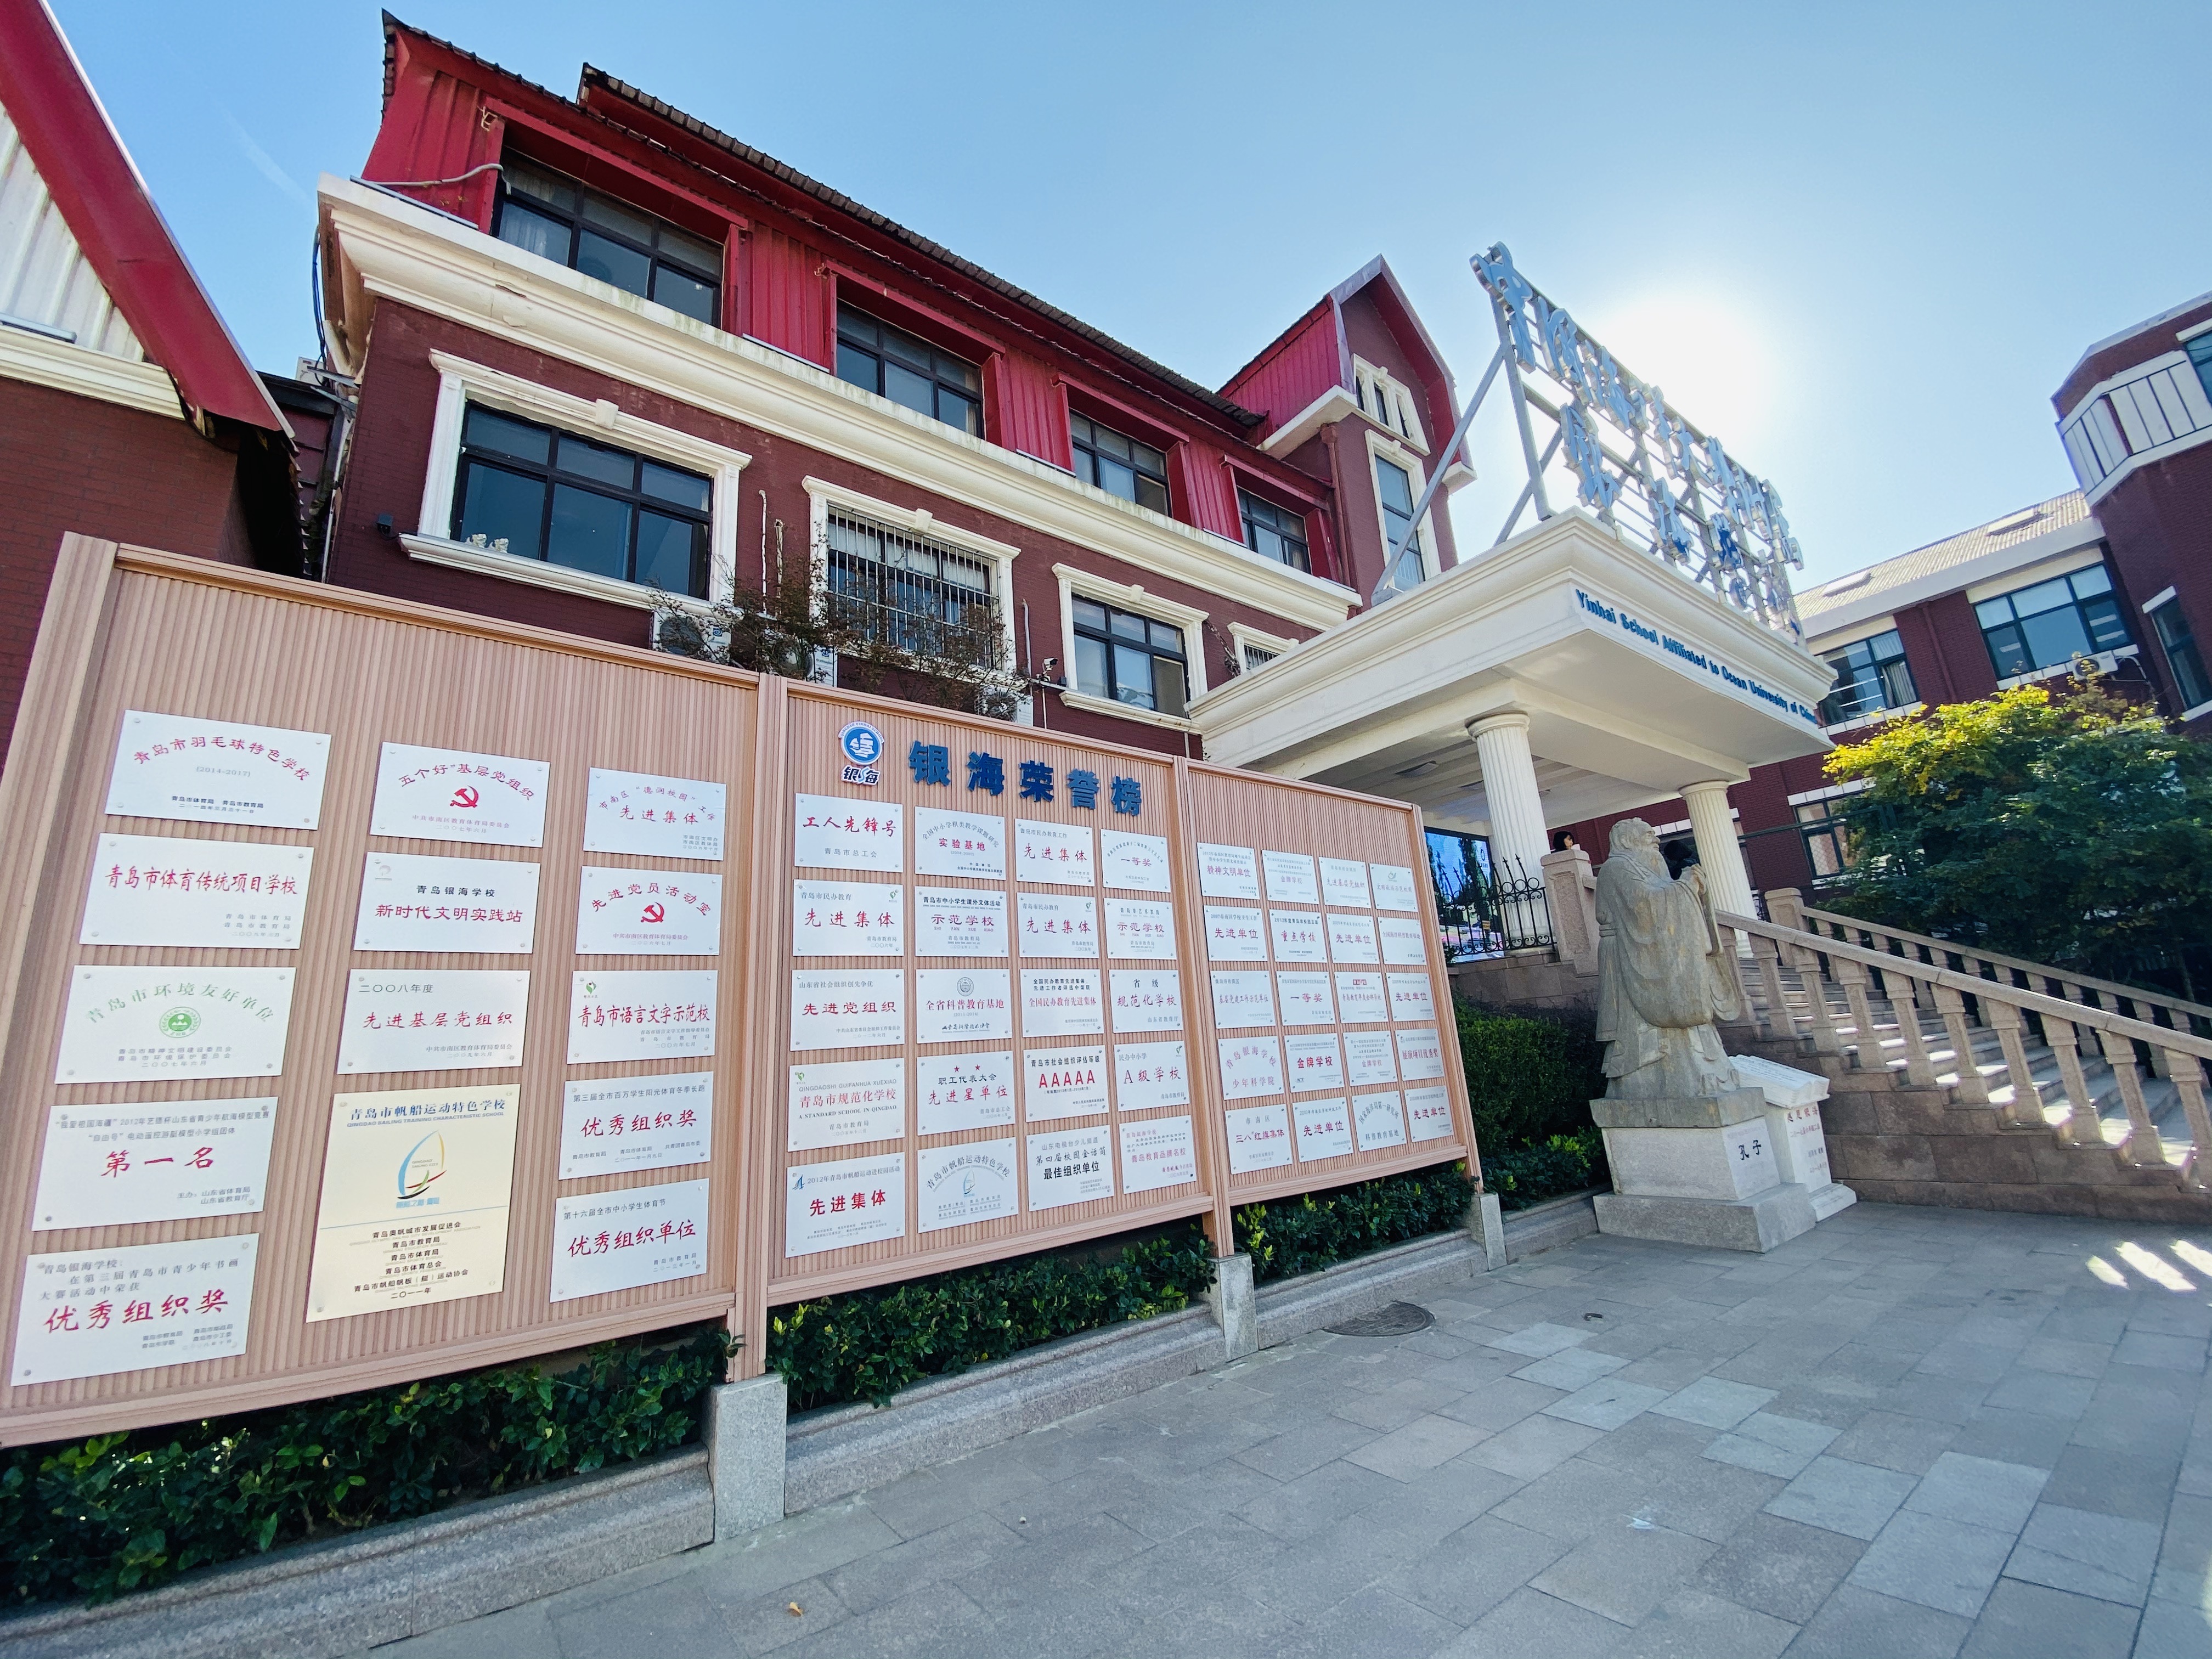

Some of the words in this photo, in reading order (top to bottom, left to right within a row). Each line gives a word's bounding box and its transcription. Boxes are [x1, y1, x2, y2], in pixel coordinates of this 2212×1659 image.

[1576, 589, 1617, 624] Yinhai
[1620, 613, 1659, 645] School
[1662, 635, 1707, 669] Affiliated
[1708, 660, 1719, 675] to
[1721, 665, 1747, 690] Ocean
[1748, 679, 1788, 712] University
[1790, 702, 1798, 714] of
[134, 737, 309, 781] 青岛市羽毛球特色学校
[195, 766, 251, 778] (2014-2017)
[908, 740, 1142, 817] 银海荣誉榜
[172, 795, 215, 804] 青岛市体育局
[223, 799, 264, 809] 青岛市教育局
[412, 814, 510, 828] 中共市南区教育体育局委员会
[620, 805, 699, 825] 先进集体
[803, 815, 896, 837] 工人先锋号
[1020, 828, 1068, 838] 青岛市民办教育工作
[939, 838, 985, 851] 实验基地
[825, 848, 877, 859] 青岛市总工会
[1024, 843, 1087, 863] 先进集体
[1120, 857, 1152, 866] 一等奖
[1207, 865, 1251, 877] 精神文明单位
[104, 864, 297, 895] 青岛市体育传统项目学校
[1327, 878, 1365, 888] 先进基层党组织
[416, 885, 495, 897] 青岛银海学校
[800, 891, 852, 901] 青岛市民办教育
[591, 882, 711, 916] 先进党员活动室
[923, 896, 1001, 907] 青岛市中小学生课外文体活动
[375, 904, 523, 922] 新时代文明实践站
[804, 908, 895, 928] 先进集体
[931, 914, 995, 927] 示范学校
[1026, 917, 1091, 934] 先进集体
[1117, 922, 1164, 933] 示范学校
[1214, 928, 1259, 939] 先进单位
[1336, 934, 1372, 944] 先进单位
[359, 984, 434, 994] 二〇〇八年度
[799, 980, 873, 989] 山东省社会组织创先争优
[1133, 979, 1158, 988] 省级
[86, 981, 273, 1023] 青岛市环境友好单位
[1029, 996, 1097, 1007] 全国民办教育先进集体
[1117, 994, 1177, 1007] 规范化学校
[1290, 992, 1323, 1003] 一等奖
[1396, 992, 1427, 1002] 先进单位
[802, 1001, 896, 1015] 先进党组织
[926, 999, 1005, 1011] 全省科普教育基地
[363, 1011, 513, 1029] 先进基层党组织
[578, 1002, 710, 1028] 青岛市语言文字示范校
[425, 1043, 513, 1052] 中共市南区教育体育局委员会
[1119, 1053, 1147, 1061] 民办中小学
[1297, 1055, 1333, 1069] 金牌学校
[938, 1073, 997, 1085] 职工代表大会
[1124, 1066, 1181, 1084] A级学校
[1232, 1076, 1274, 1089] 少年科学院
[573, 1085, 705, 1103] 第三届全市百万学生阳光体育冬季长跑
[800, 1088, 896, 1108] 青岛市规范化学校
[351, 1099, 506, 1120] 青岛市帆船运动特色学校
[1414, 1106, 1446, 1120] 先进单位
[580, 1109, 697, 1137] 优秀组织奖
[830, 1120, 869, 1130] 青岛市教育局
[1304, 1120, 1344, 1137] 先进单位
[1042, 1137, 1098, 1150] 山东电视台少儿频道
[1738, 1139, 1762, 1161] 孔子
[100, 1147, 214, 1178] 第一名
[572, 1151, 607, 1160] 青岛市教育局
[1036, 1146, 1106, 1166] 第四届校园金话筒
[927, 1155, 1010, 1189] 青岛市帆船运动特色学校
[1043, 1160, 1100, 1180] 最佳组织单位
[200, 1194, 250, 1204] 山东省教育厅
[201, 1186, 251, 1198] 山东省体育局
[563, 1198, 666, 1221] 第十六届全市中小学生体育节
[810, 1189, 886, 1217] 先进集体
[372, 1221, 461, 1239] 青岛奥帆城市发展促进会
[392, 1236, 440, 1248] 青岛市教育局
[567, 1219, 696, 1257] 优秀组织单位
[391, 1249, 439, 1261] 青岛市体育局
[653, 1253, 697, 1266] 青岛市教育局
[69, 1258, 239, 1285] 在第三届青岛市青少年书画
[385, 1261, 442, 1274] 青岛市体育总会
[40, 1282, 140, 1301] 大赛活动中荣获
[391, 1287, 431, 1299] 二〇一一年
[43, 1288, 228, 1334] 优秀组织奖
